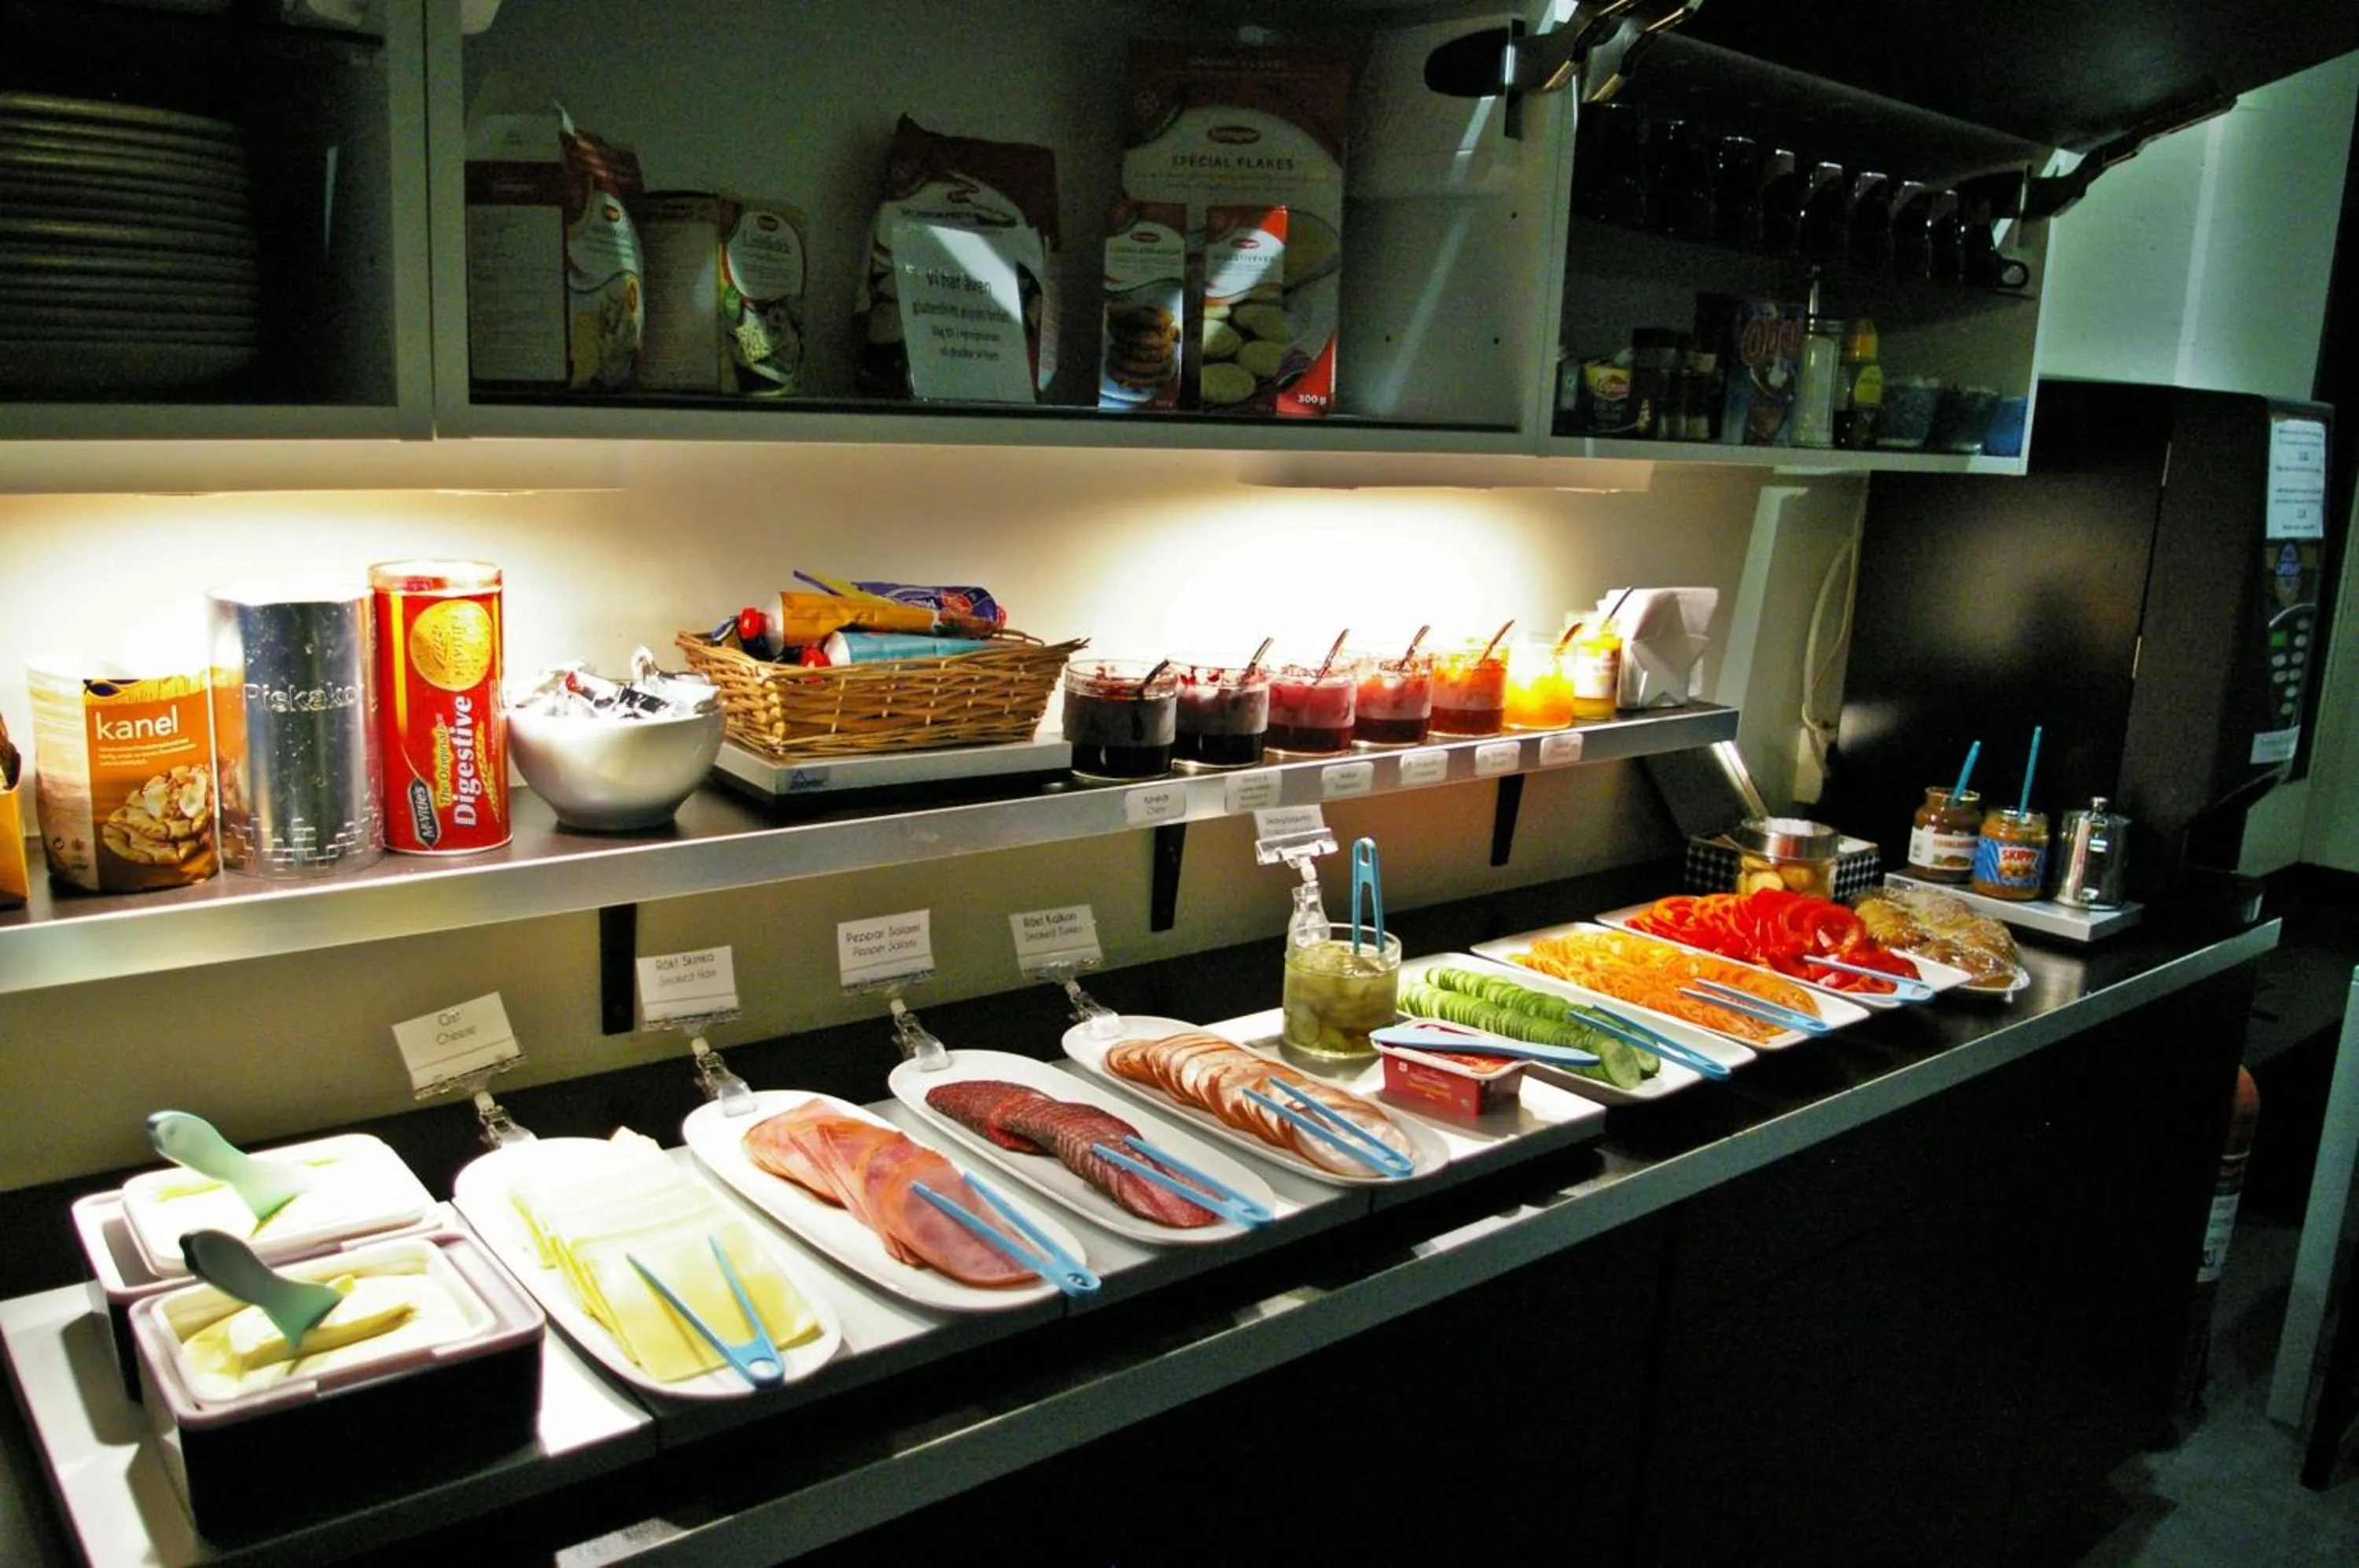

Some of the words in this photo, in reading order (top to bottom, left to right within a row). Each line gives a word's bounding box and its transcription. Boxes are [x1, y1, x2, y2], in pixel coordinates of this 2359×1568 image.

[1172, 154, 1231, 169] SPECIAL
[1236, 156, 1295, 171] FLAKES
[1297, 393, 1319, 404] 300
[1319, 395, 1328, 407] g
[95, 704, 179, 741] kanel
[449, 695, 483, 827] Digestive
